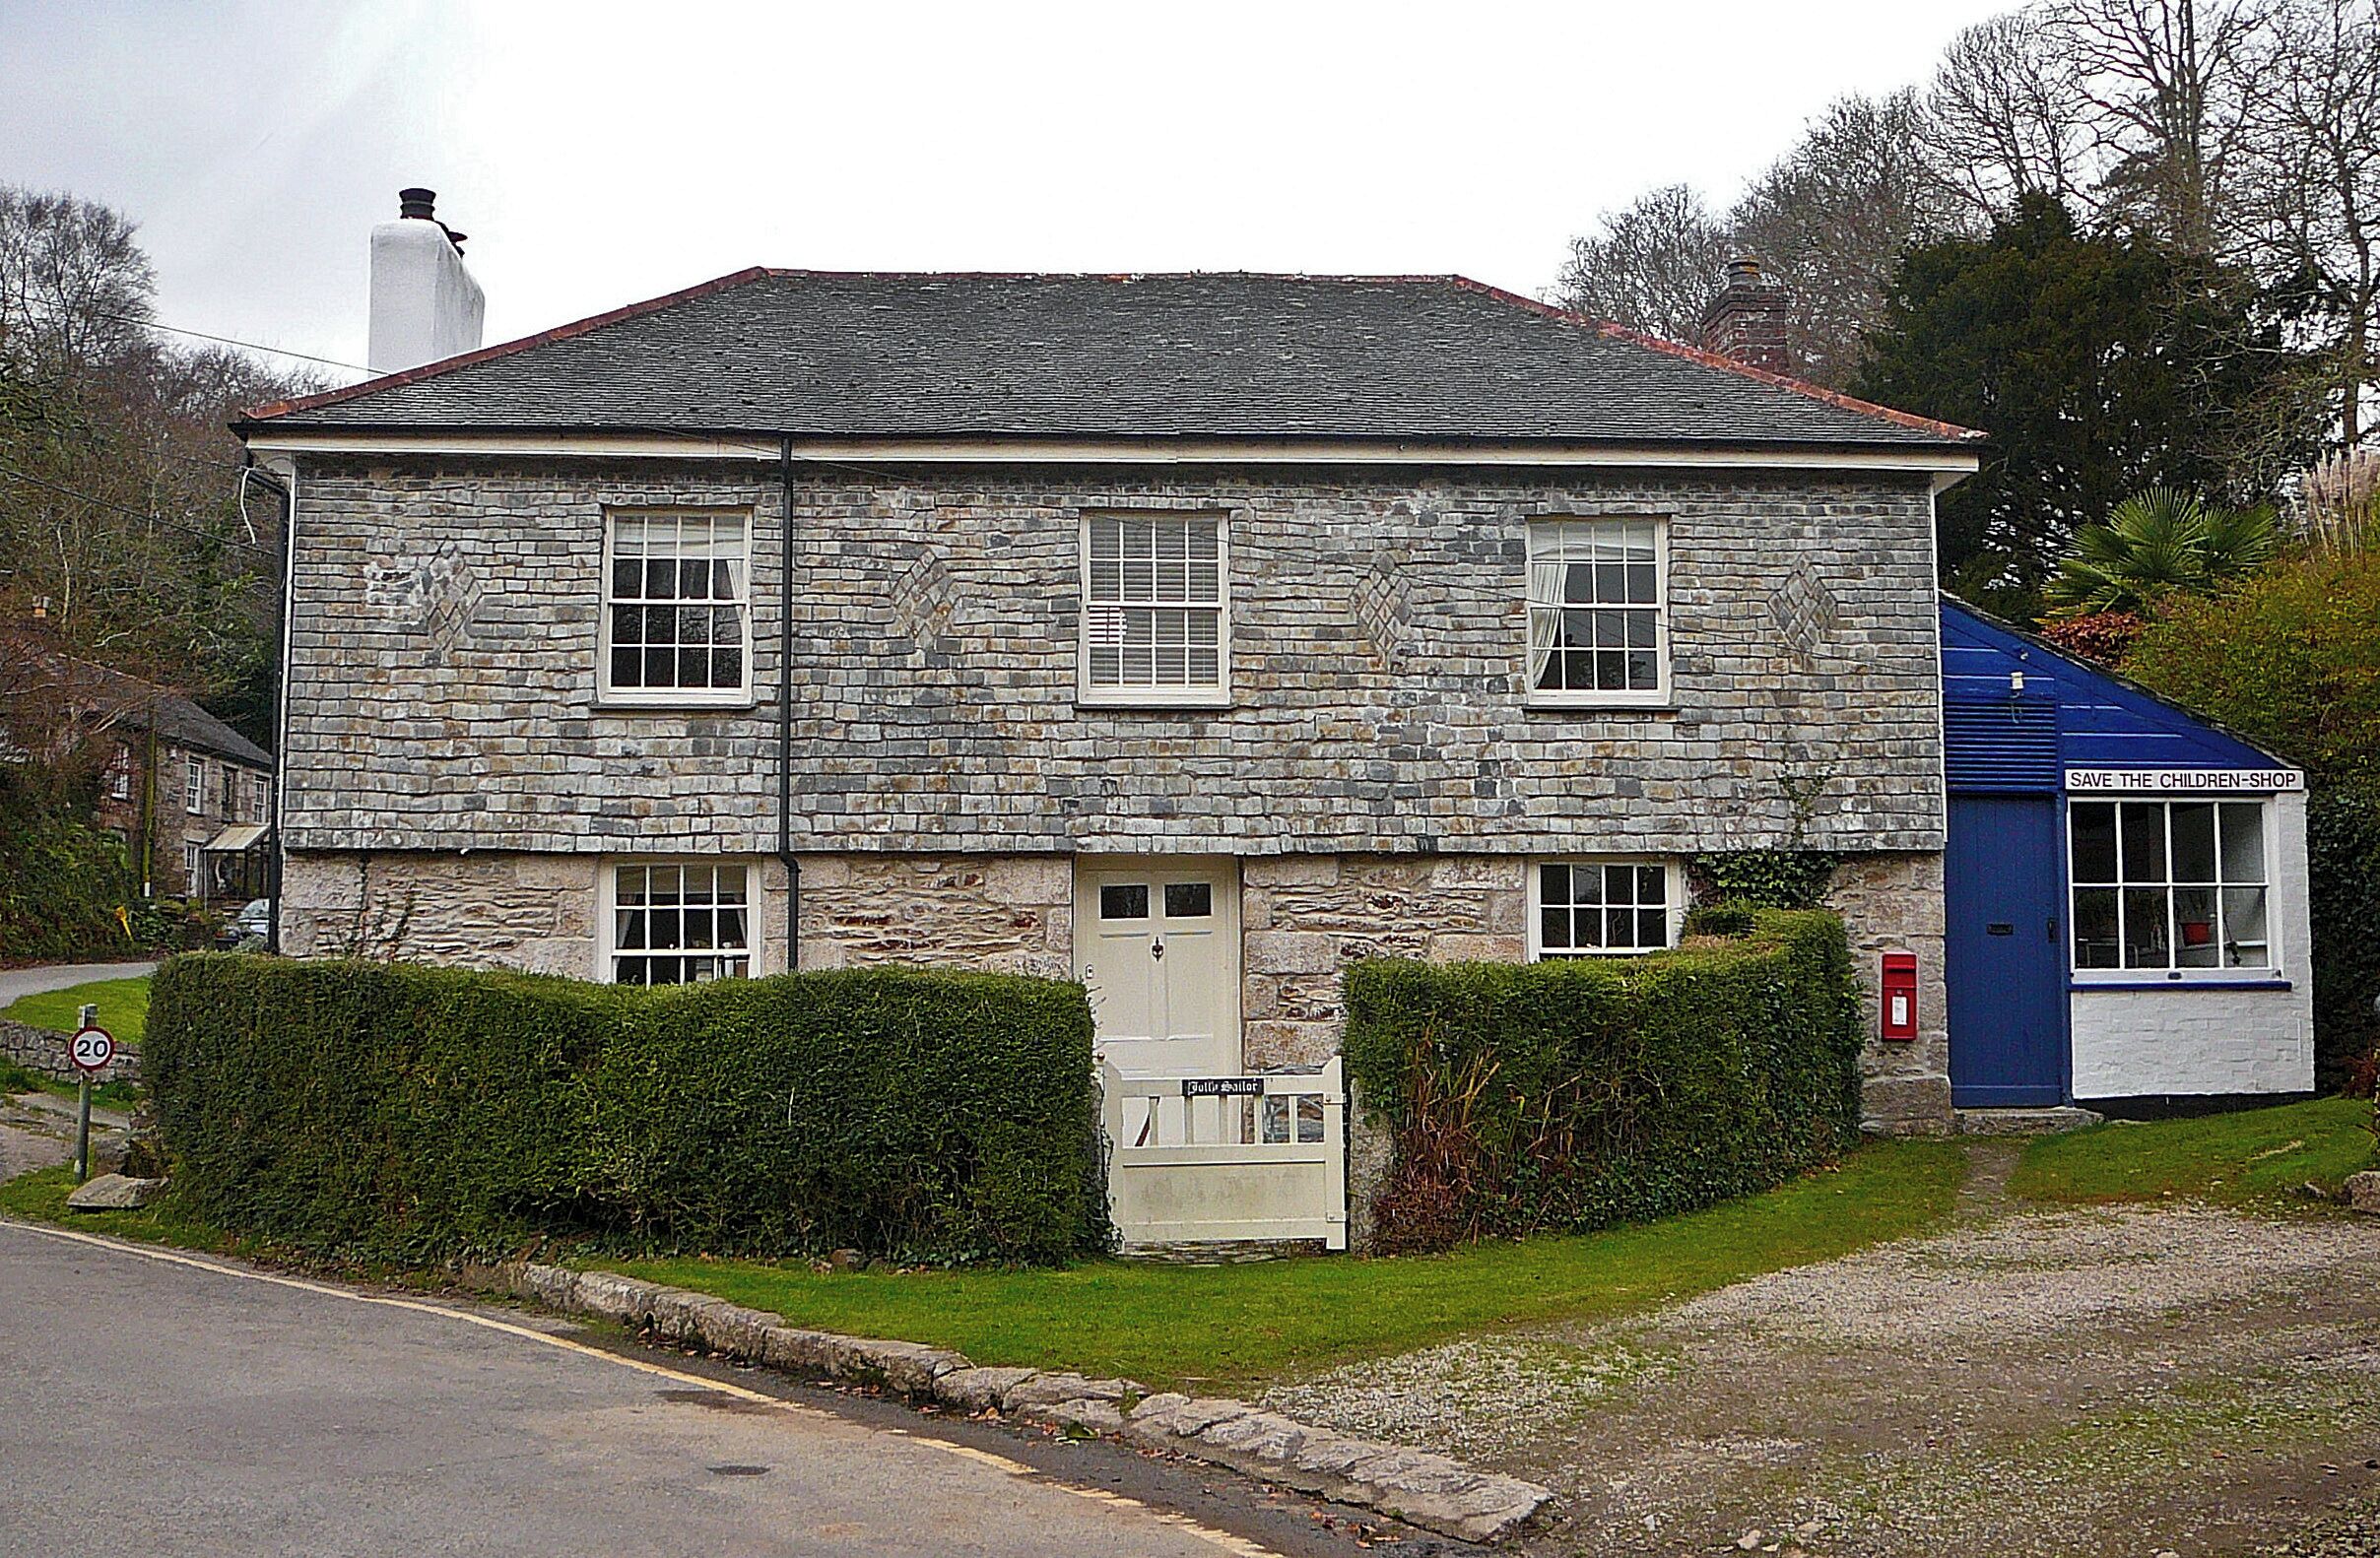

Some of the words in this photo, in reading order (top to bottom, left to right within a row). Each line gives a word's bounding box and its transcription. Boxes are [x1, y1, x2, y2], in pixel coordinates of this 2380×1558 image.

[2070, 772, 2112, 788] SAVE
[2119, 772, 2152, 788] THE
[2159, 772, 2296, 788] CHILDREN-SHOP
[77, 1039, 108, 1058] 20
[1188, 1081, 1219, 1095] Jolly
[1222, 1080, 1258, 1092] Sailor
